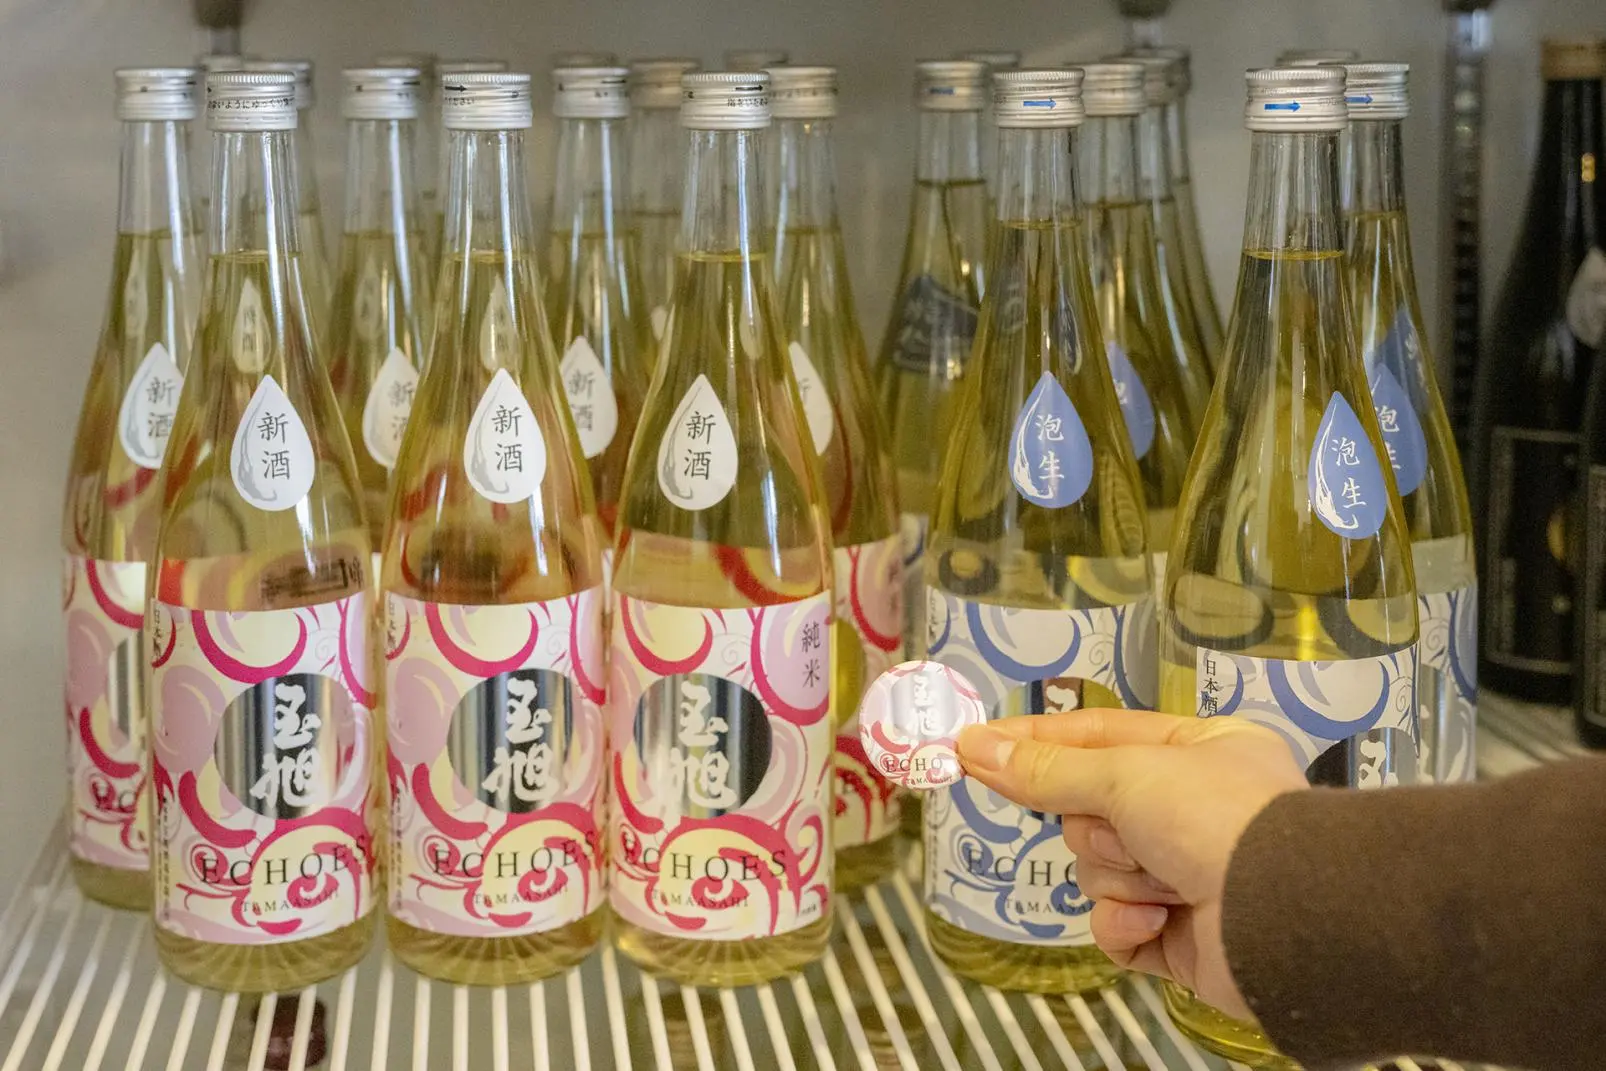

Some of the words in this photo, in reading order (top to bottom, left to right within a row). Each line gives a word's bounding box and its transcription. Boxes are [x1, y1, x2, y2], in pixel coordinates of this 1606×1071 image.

[146, 376, 177, 438] 新酒
[491, 405, 524, 473] 新酒
[257, 411, 292, 480] 新酒
[683, 411, 716, 481] 新酒
[1035, 414, 1065, 481] 泡生
[1331, 437, 1368, 510] 泡生
[801, 621, 820, 688] 純米
[1201, 659, 1218, 716] 日本酒
[201, 834, 367, 886] ECHOES
[434, 830, 594, 879] ECHOES
[621, 831, 786, 882] ECHOES
